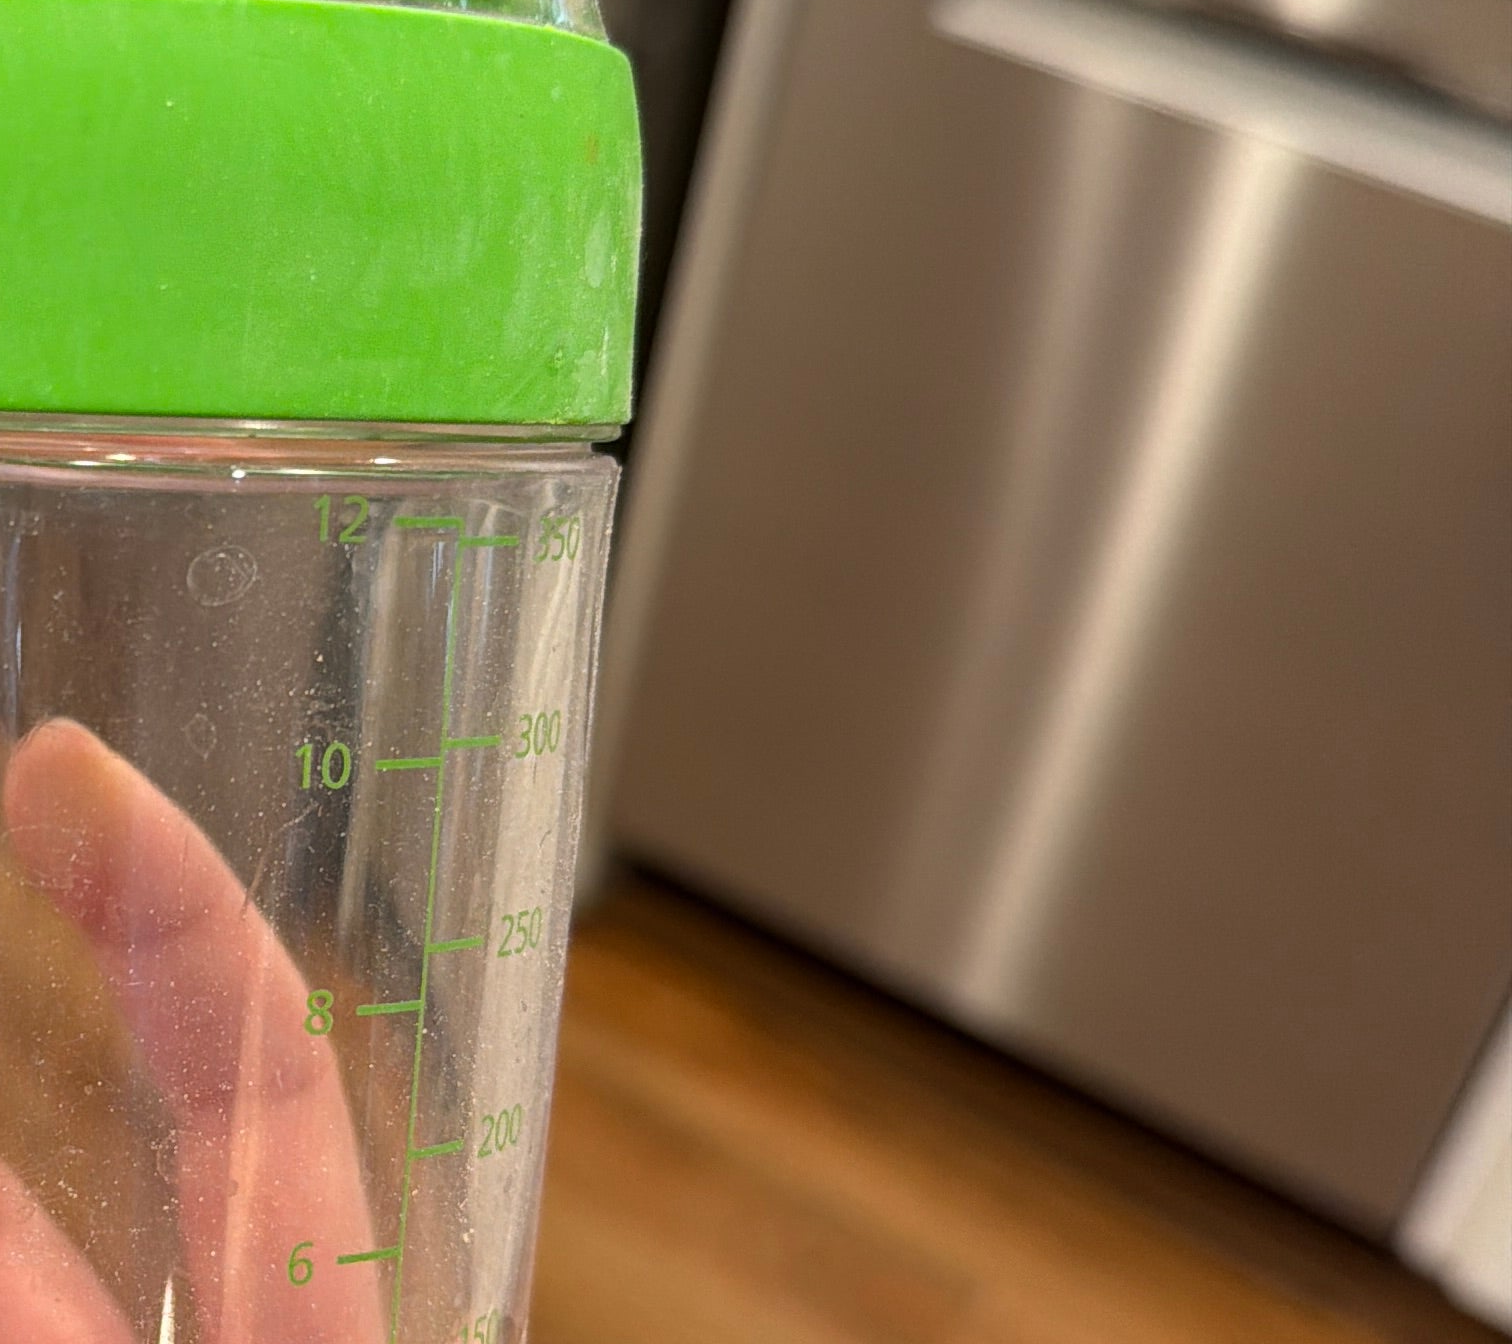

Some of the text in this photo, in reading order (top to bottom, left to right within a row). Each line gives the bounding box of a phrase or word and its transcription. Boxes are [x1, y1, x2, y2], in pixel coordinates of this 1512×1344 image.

[314, 494, 369, 545] 12
[533, 515, 580, 563] 350
[514, 709, 561, 760] 300
[295, 742, 352, 790] 10
[497, 907, 543, 959] 250
[304, 989, 334, 1036] 8
[477, 1103, 523, 1159] 200
[288, 1241, 314, 1287] 6
